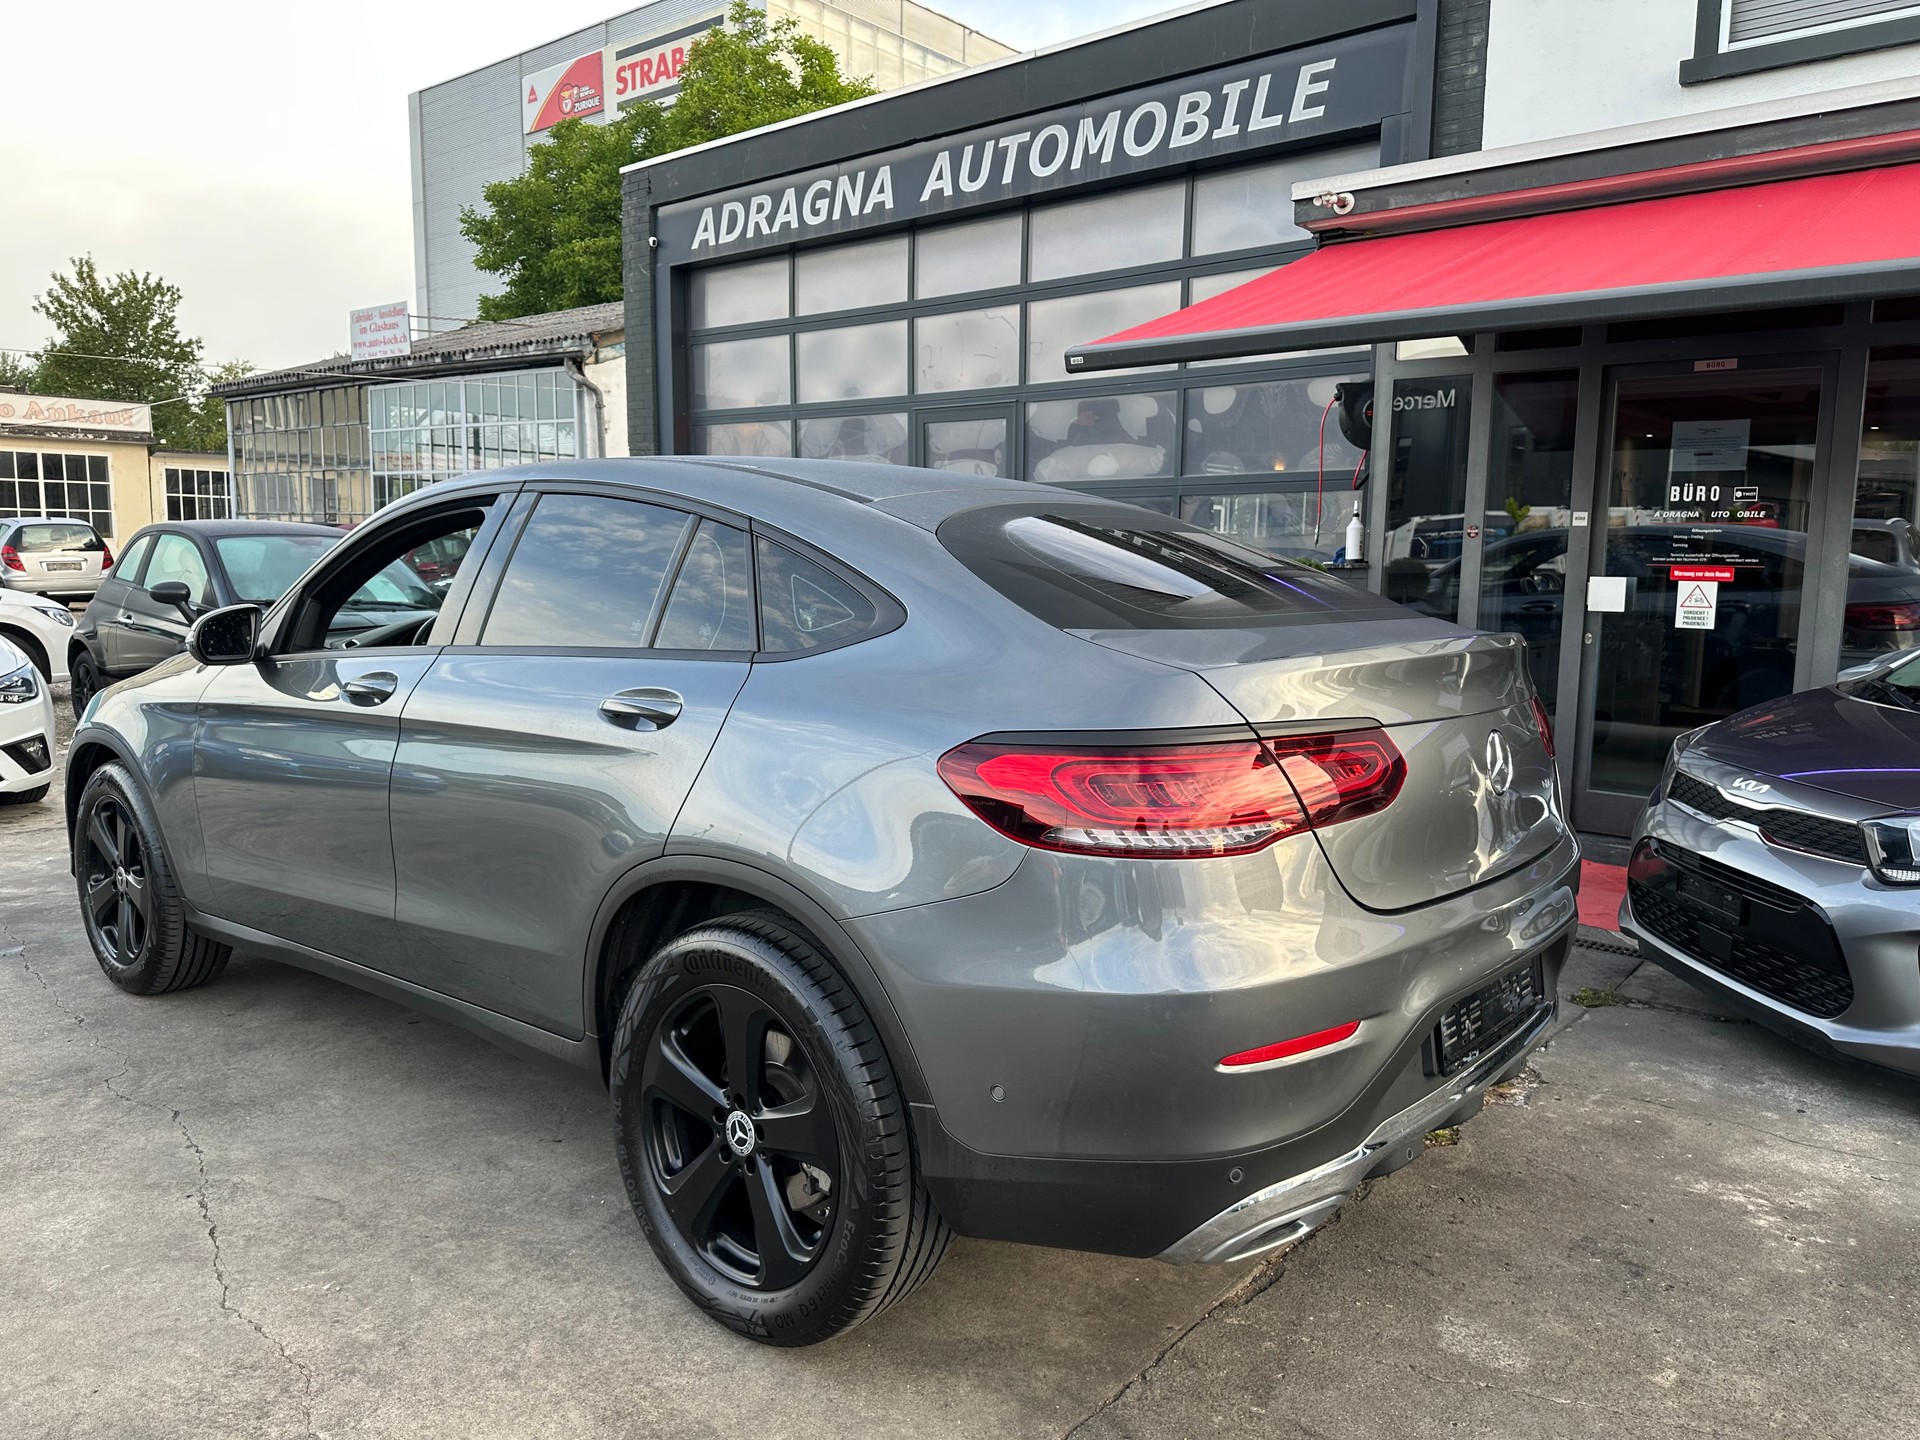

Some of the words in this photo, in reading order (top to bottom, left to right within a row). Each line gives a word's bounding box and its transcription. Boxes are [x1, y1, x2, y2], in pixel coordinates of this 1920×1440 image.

[574, 96, 600, 112] ZURIQUE
[691, 165, 894, 250] ADRAGNA
[919, 58, 1337, 202] AUTOMOBILE
[359, 324, 367, 334] im
[369, 320, 399, 333] Glashaus
[353, 332, 407, 348] www.auto-koch.ch
[23, 401, 134, 426] Ankauf
[1670, 483, 1720, 502] BÜRO
[683, 950, 775, 994] Continenta
